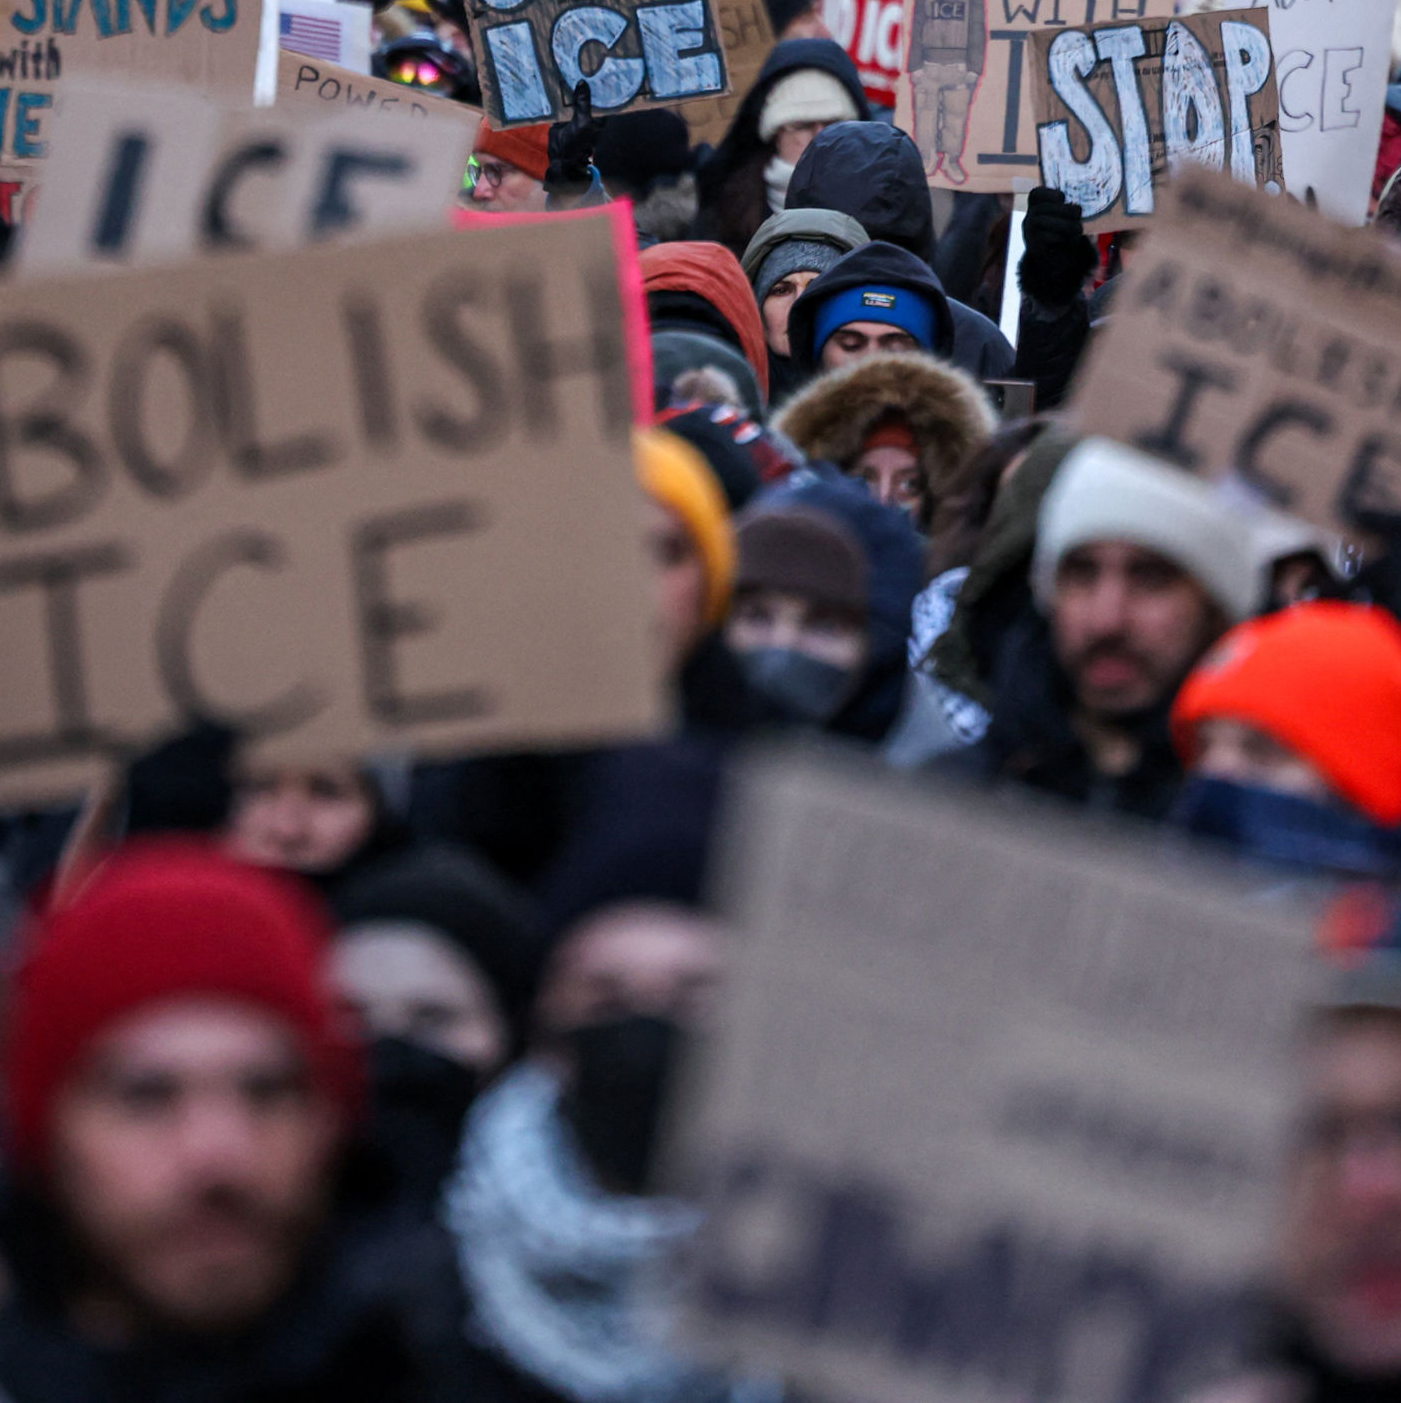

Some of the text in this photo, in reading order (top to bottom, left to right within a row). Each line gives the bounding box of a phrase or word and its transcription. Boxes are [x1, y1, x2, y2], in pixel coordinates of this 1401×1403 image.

[484, 0, 724, 122] ICE
[932, 1, 965, 20] ICE
[1037, 19, 1272, 218] STOP
[1279, 46, 1365, 134] CE
